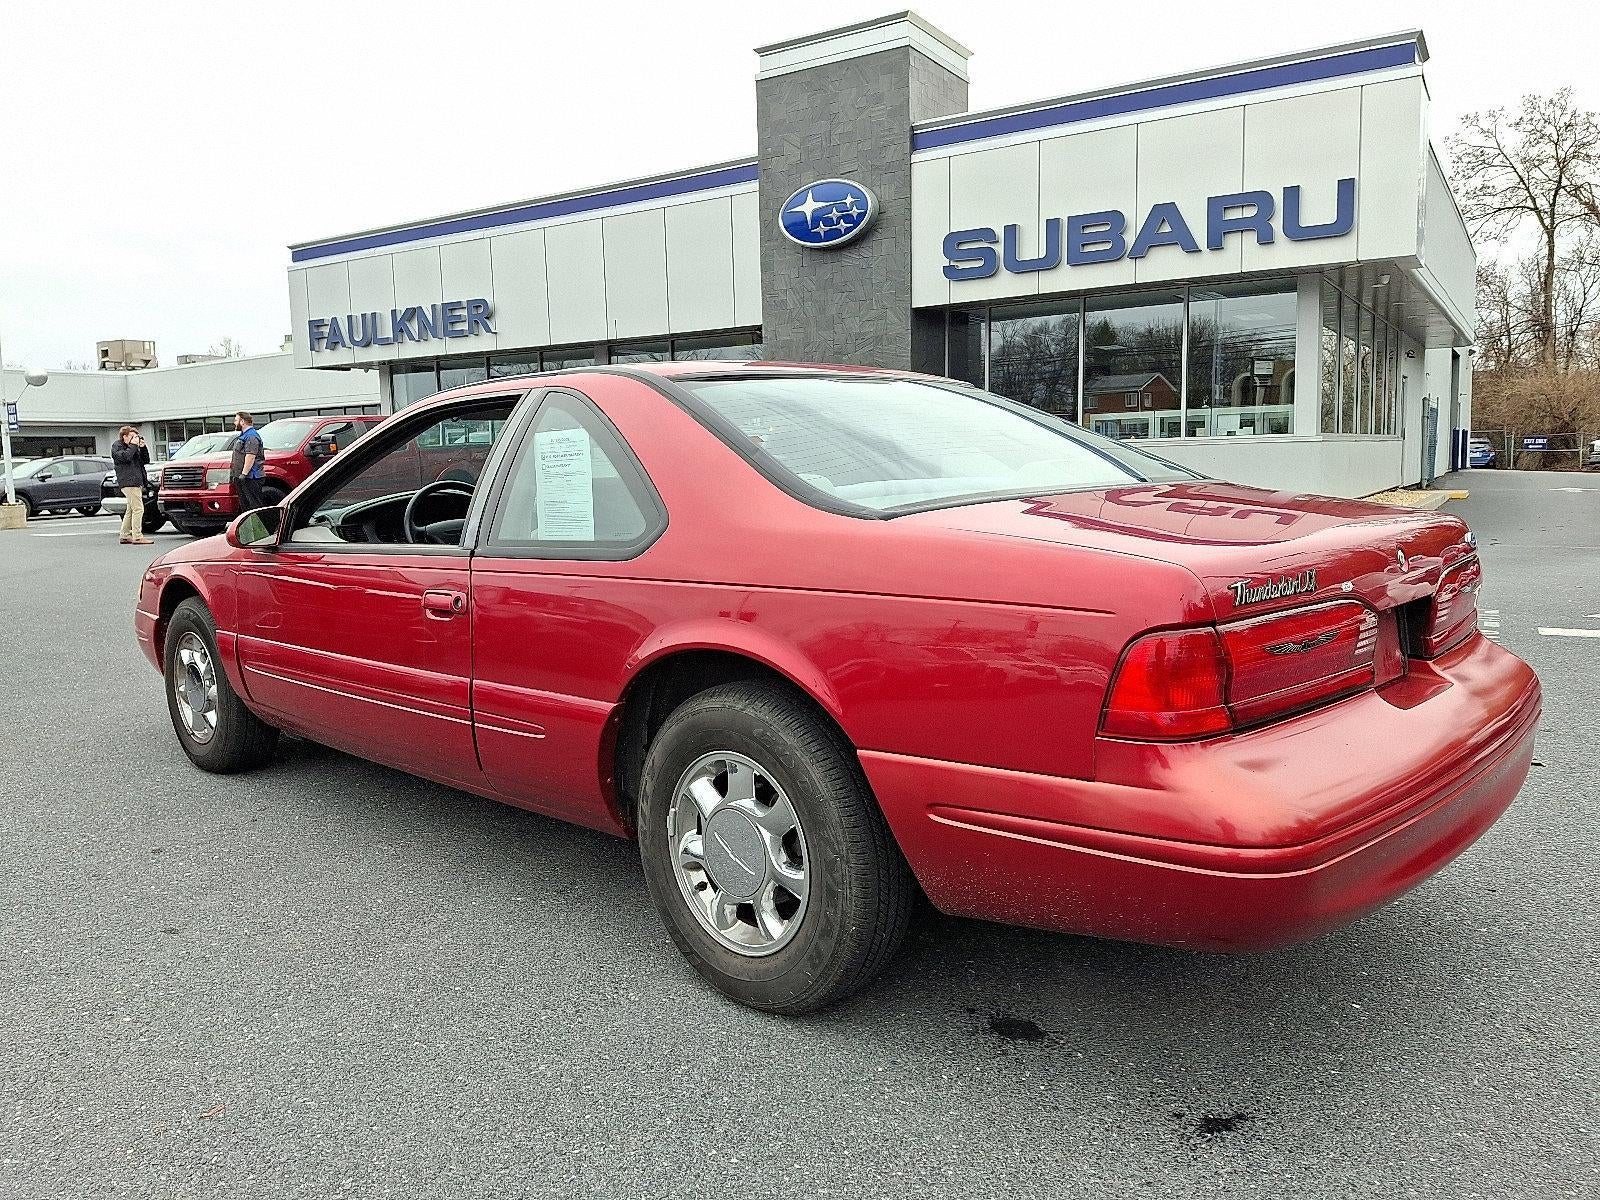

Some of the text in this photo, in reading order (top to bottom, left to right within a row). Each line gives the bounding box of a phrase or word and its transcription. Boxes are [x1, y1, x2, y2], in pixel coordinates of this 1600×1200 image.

[942, 177, 1356, 282] SUBARU
[308, 298, 497, 352] FAULKNER
[1228, 572, 1301, 606] Thunderbird
